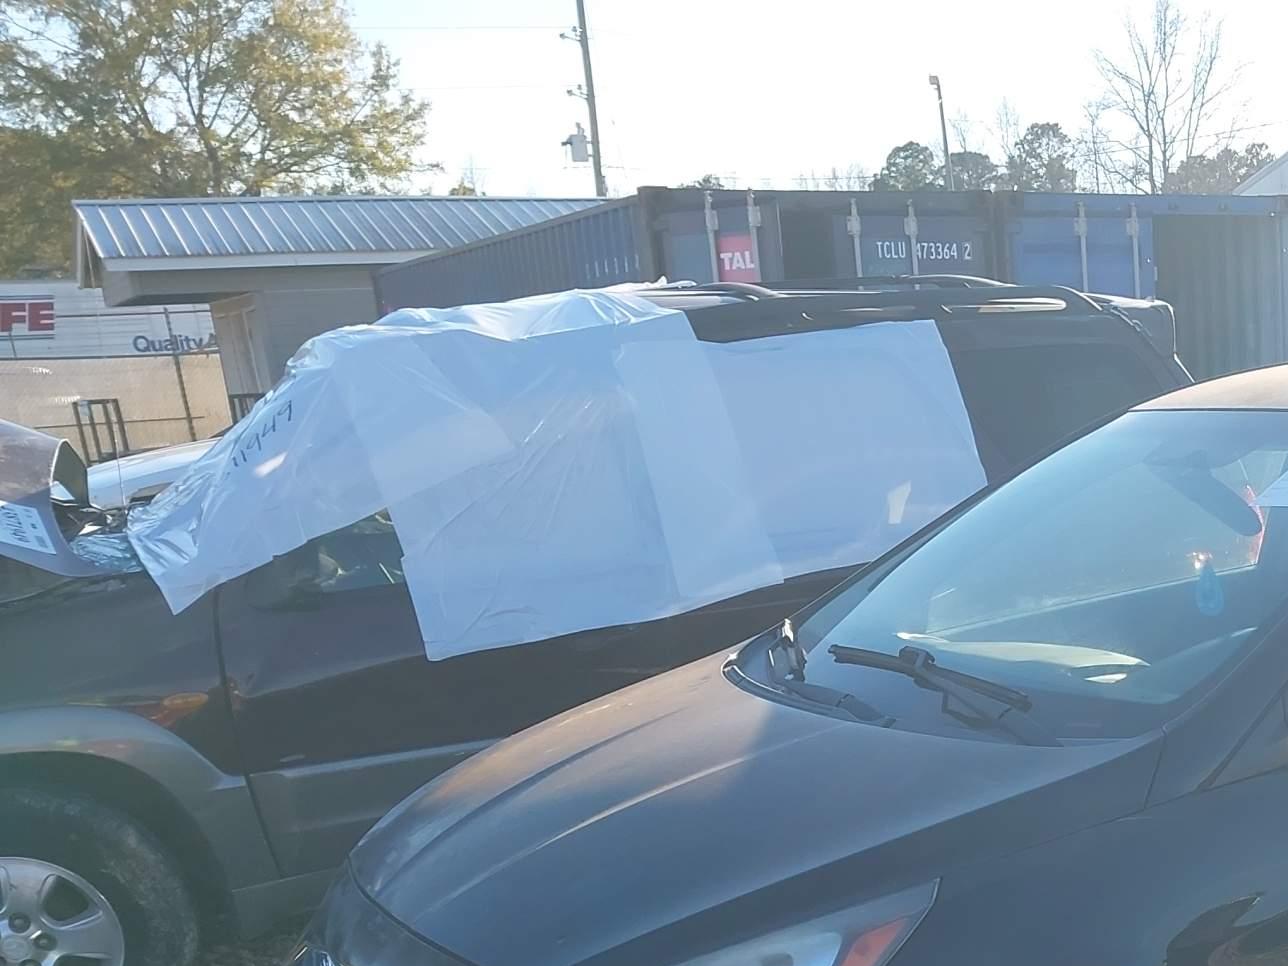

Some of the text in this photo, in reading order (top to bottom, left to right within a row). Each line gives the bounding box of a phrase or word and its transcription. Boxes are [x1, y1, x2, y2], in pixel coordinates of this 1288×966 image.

[876, 241, 906, 259] TCLU
[963, 243, 972, 260] 2
[720, 251, 756, 270] TAL
[133, 333, 204, 353] Quality
